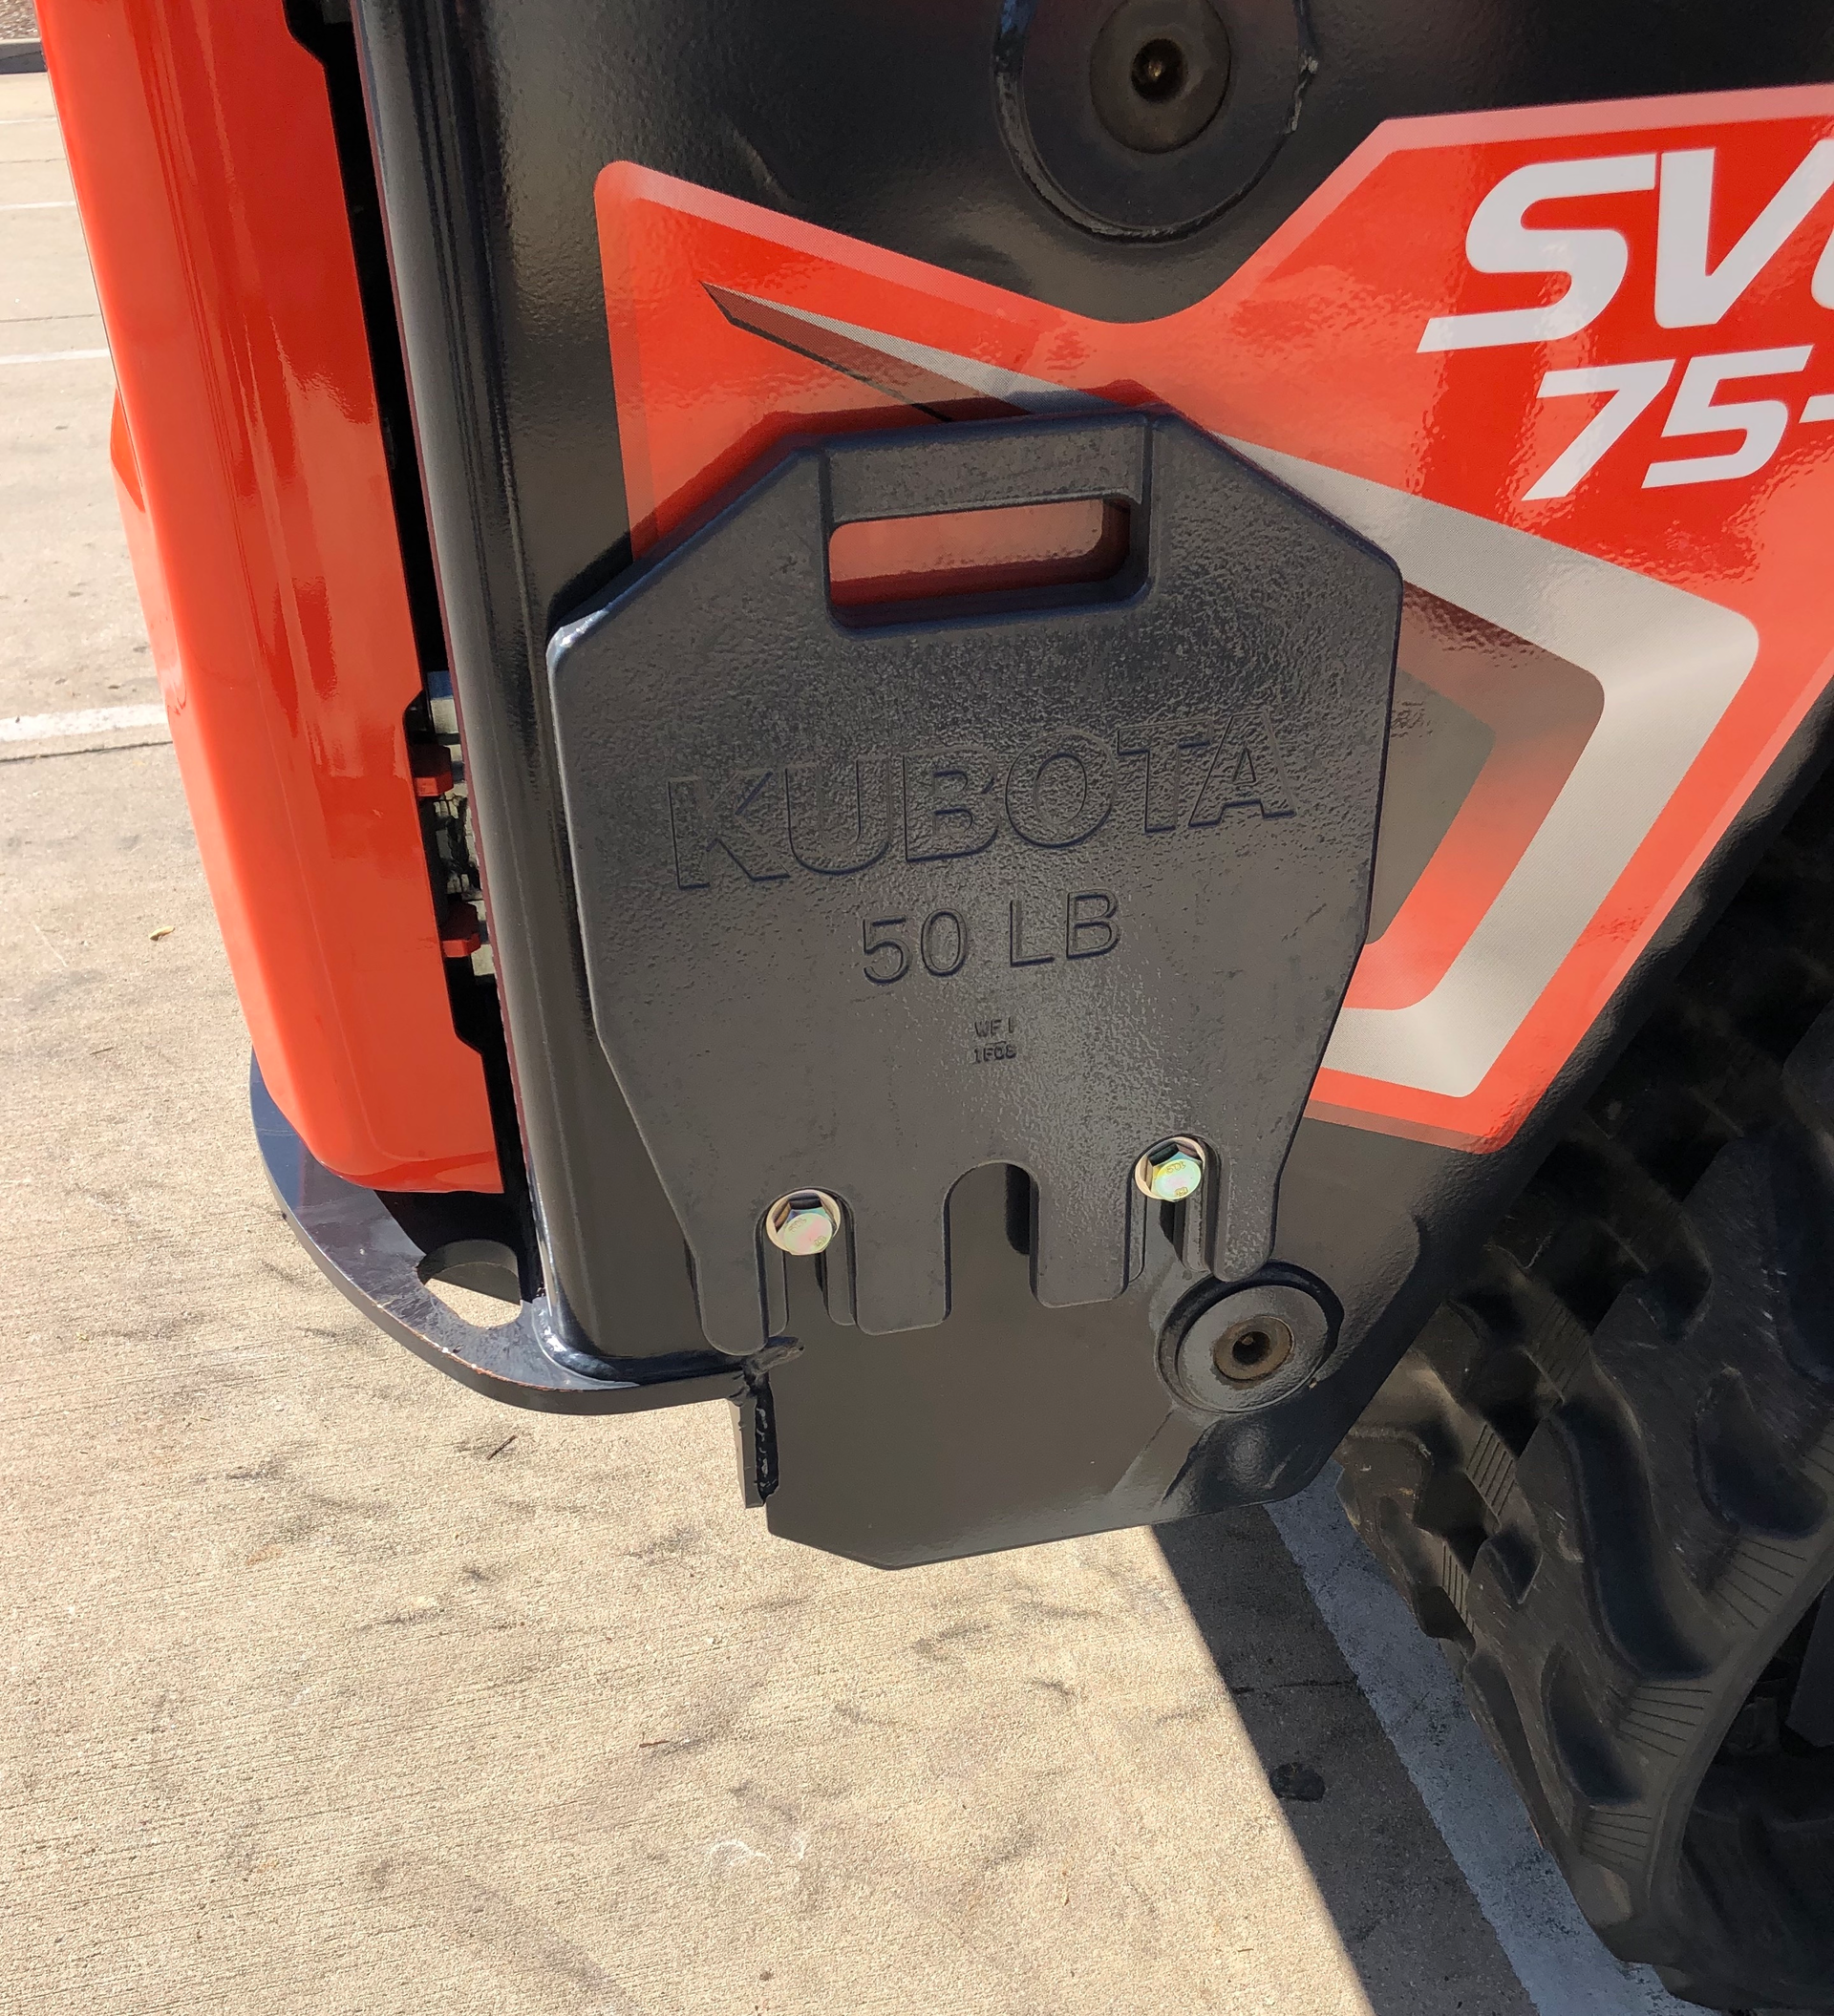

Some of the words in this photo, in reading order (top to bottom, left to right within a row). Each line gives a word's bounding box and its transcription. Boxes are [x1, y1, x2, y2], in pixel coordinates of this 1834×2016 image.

[1417, 139, 1834, 353] SV
[669, 711, 1296, 889] KUBOTA
[863, 907, 968, 986] 50
[1010, 888, 1120, 968] LB
